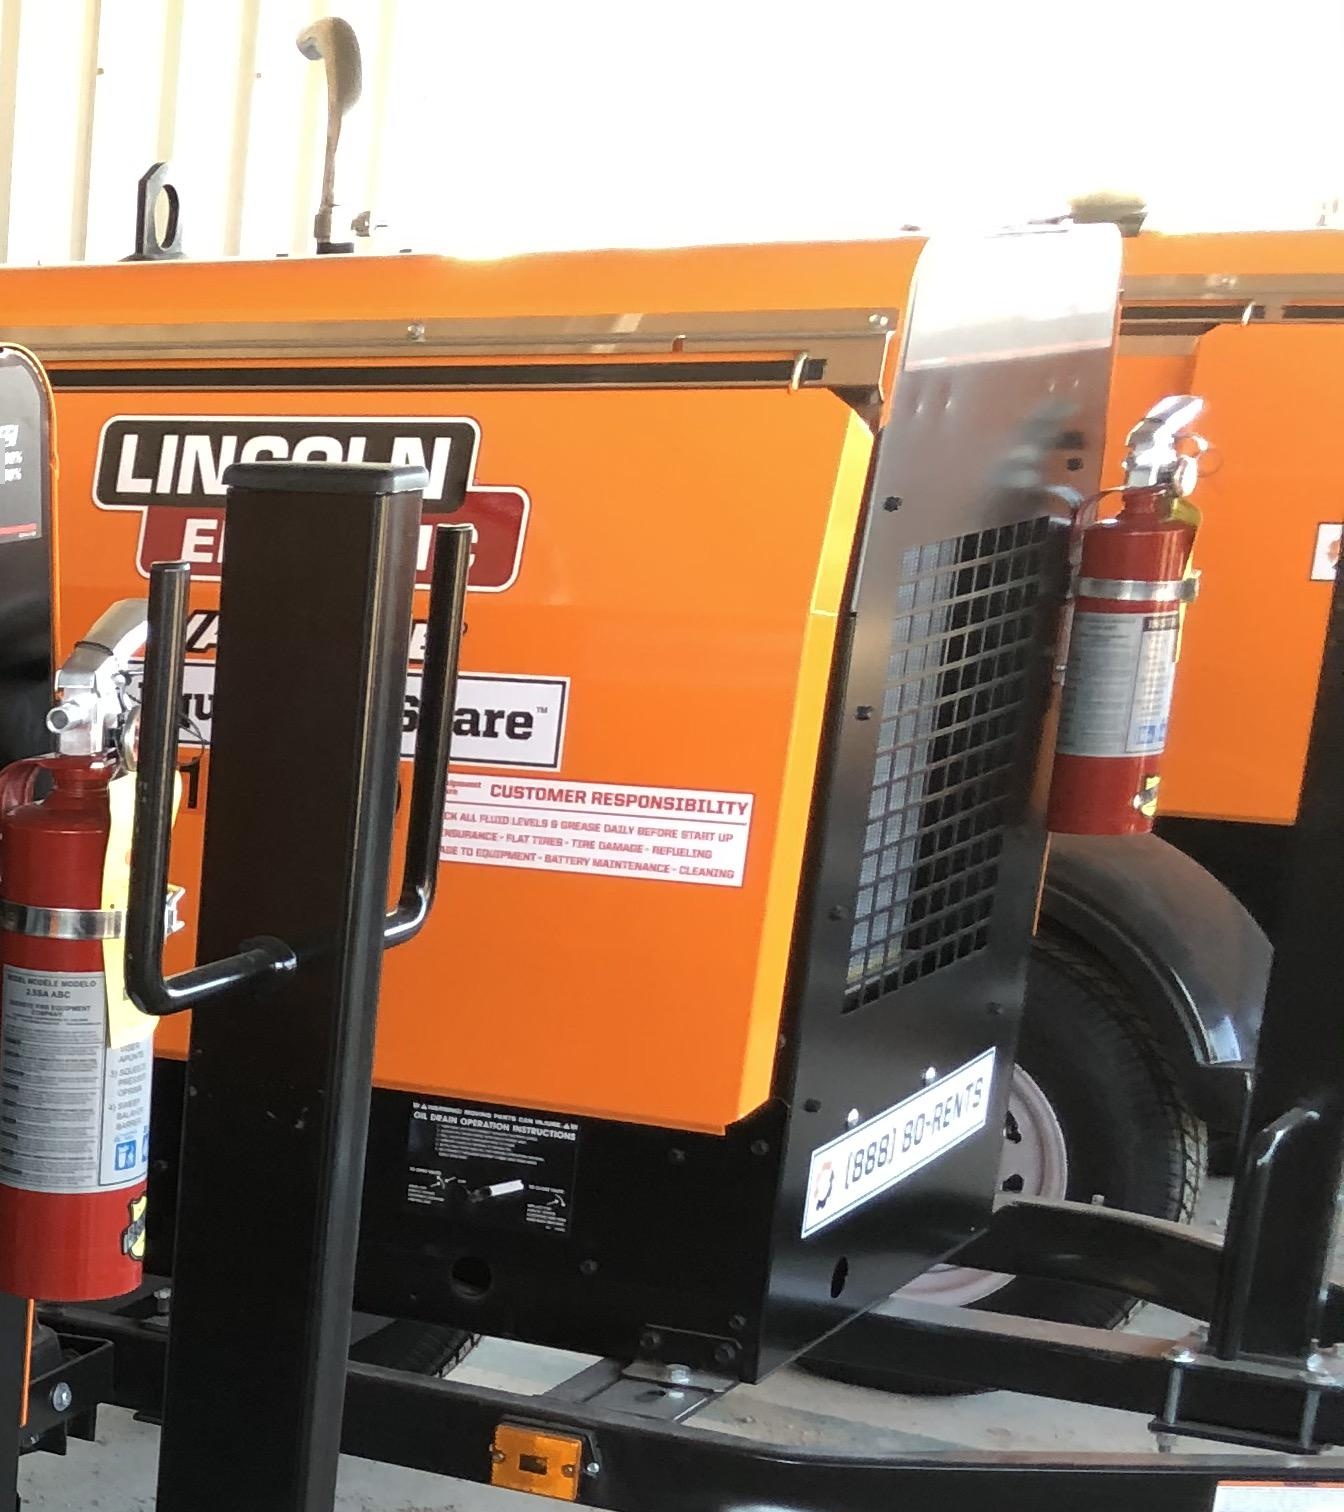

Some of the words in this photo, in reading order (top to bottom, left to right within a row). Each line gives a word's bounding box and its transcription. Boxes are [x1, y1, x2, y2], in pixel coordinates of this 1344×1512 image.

[490, 784, 587, 804] CUSTOMER
[590, 790, 748, 816] RESPONSIBILITY
[479, 814, 509, 826] FLUID
[512, 817, 548, 828] LEVELS
[560, 821, 601, 833] GREASE
[604, 823, 635, 835] DAILY
[637, 827, 678, 839] BEFORE
[681, 830, 716, 841] START
[718, 832, 734, 843] UP
[506, 833, 530, 844] FLAT
[571, 838, 595, 849] TIRE
[598, 841, 644, 854] DAMAGE
[652, 845, 713, 859] REFUELING
[461, 847, 473, 857] TO
[476, 848, 536, 862] EQUIPMENT
[544, 854, 591, 867] BATTERY
[592, 859, 671, 874] MAINTENANCE
[678, 865, 735, 879] CLEANING
[413, 1111, 428, 1121] OIL
[430, 1114, 458, 1125] DRAIN
[460, 1117, 510, 1132] OPERATION
[512, 1125, 576, 1142] INSTRUCTIONS
[845, 1128, 896, 1190] (888)
[902, 1077, 983, 1153] 80-RENTS
